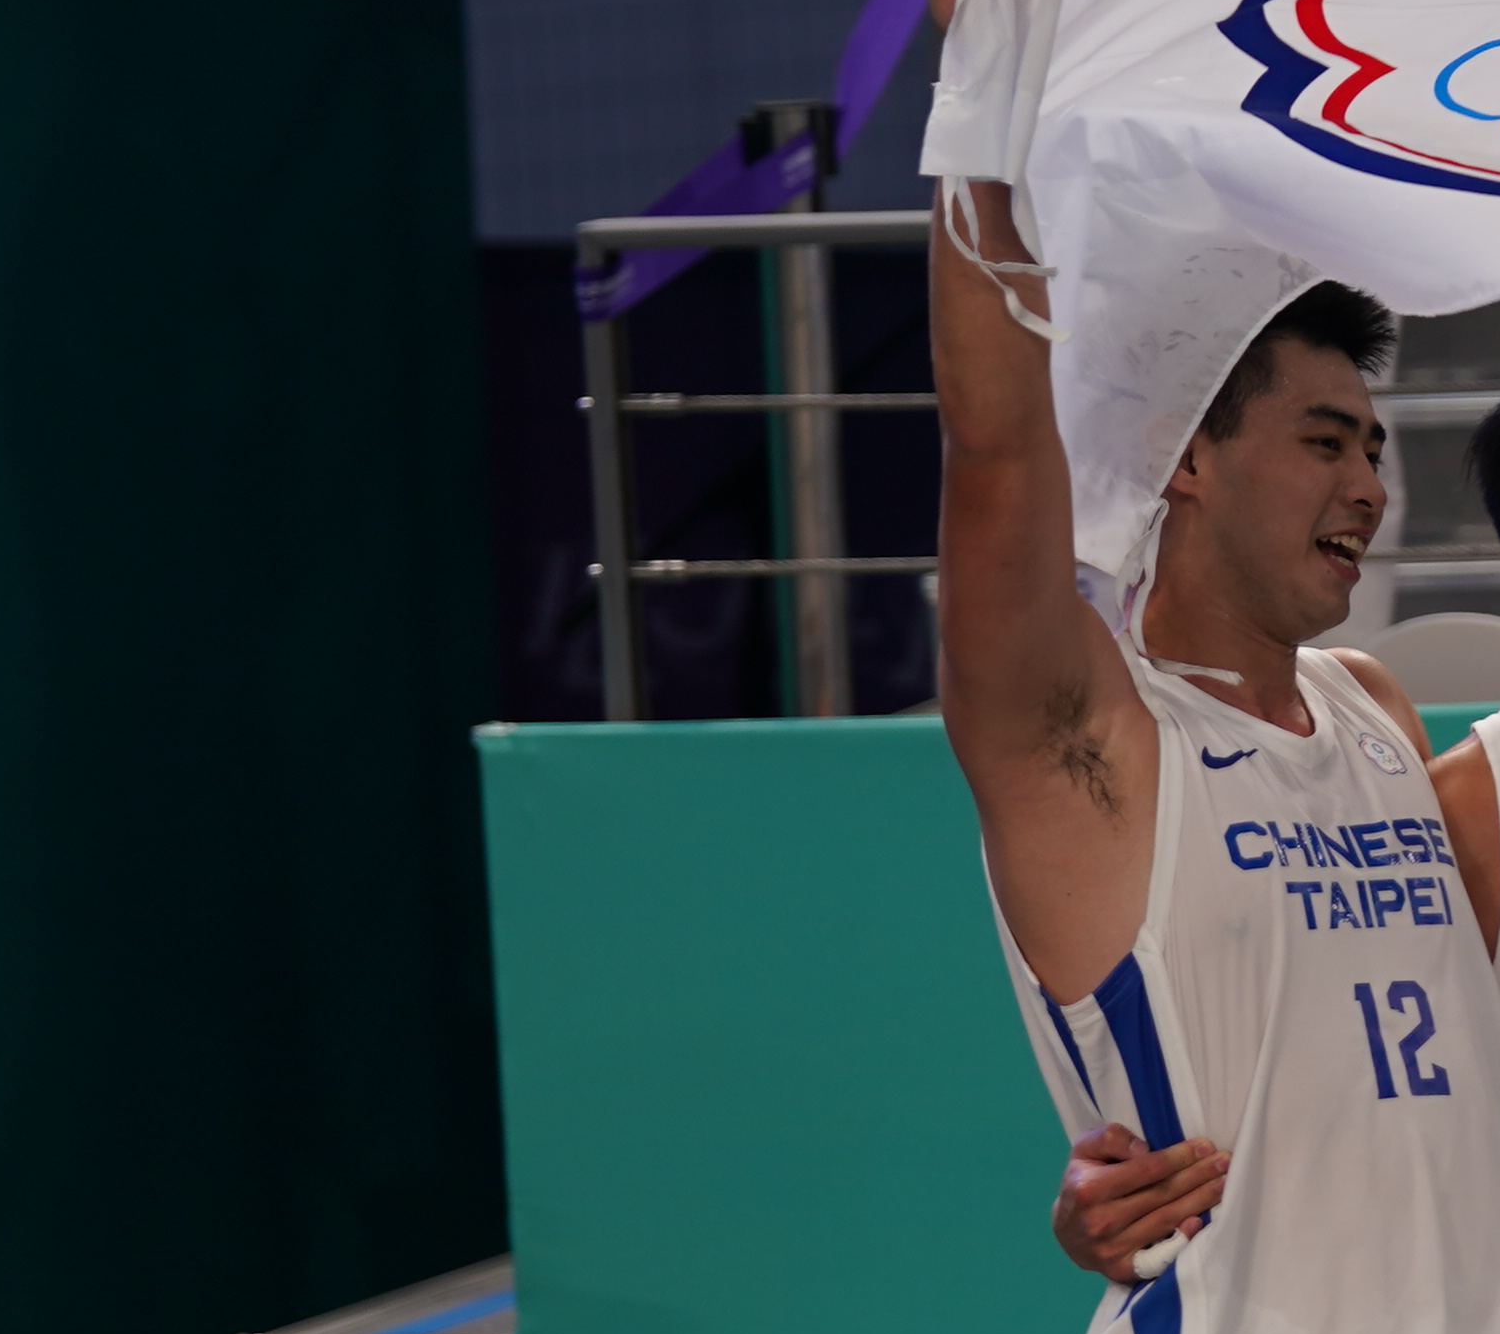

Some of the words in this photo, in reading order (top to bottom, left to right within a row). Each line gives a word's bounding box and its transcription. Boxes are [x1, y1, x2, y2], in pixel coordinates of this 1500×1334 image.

[1224, 817, 1455, 871] CHINESE
[1285, 876, 1453, 930] TAIPEI
[1353, 979, 1451, 1100] 12
